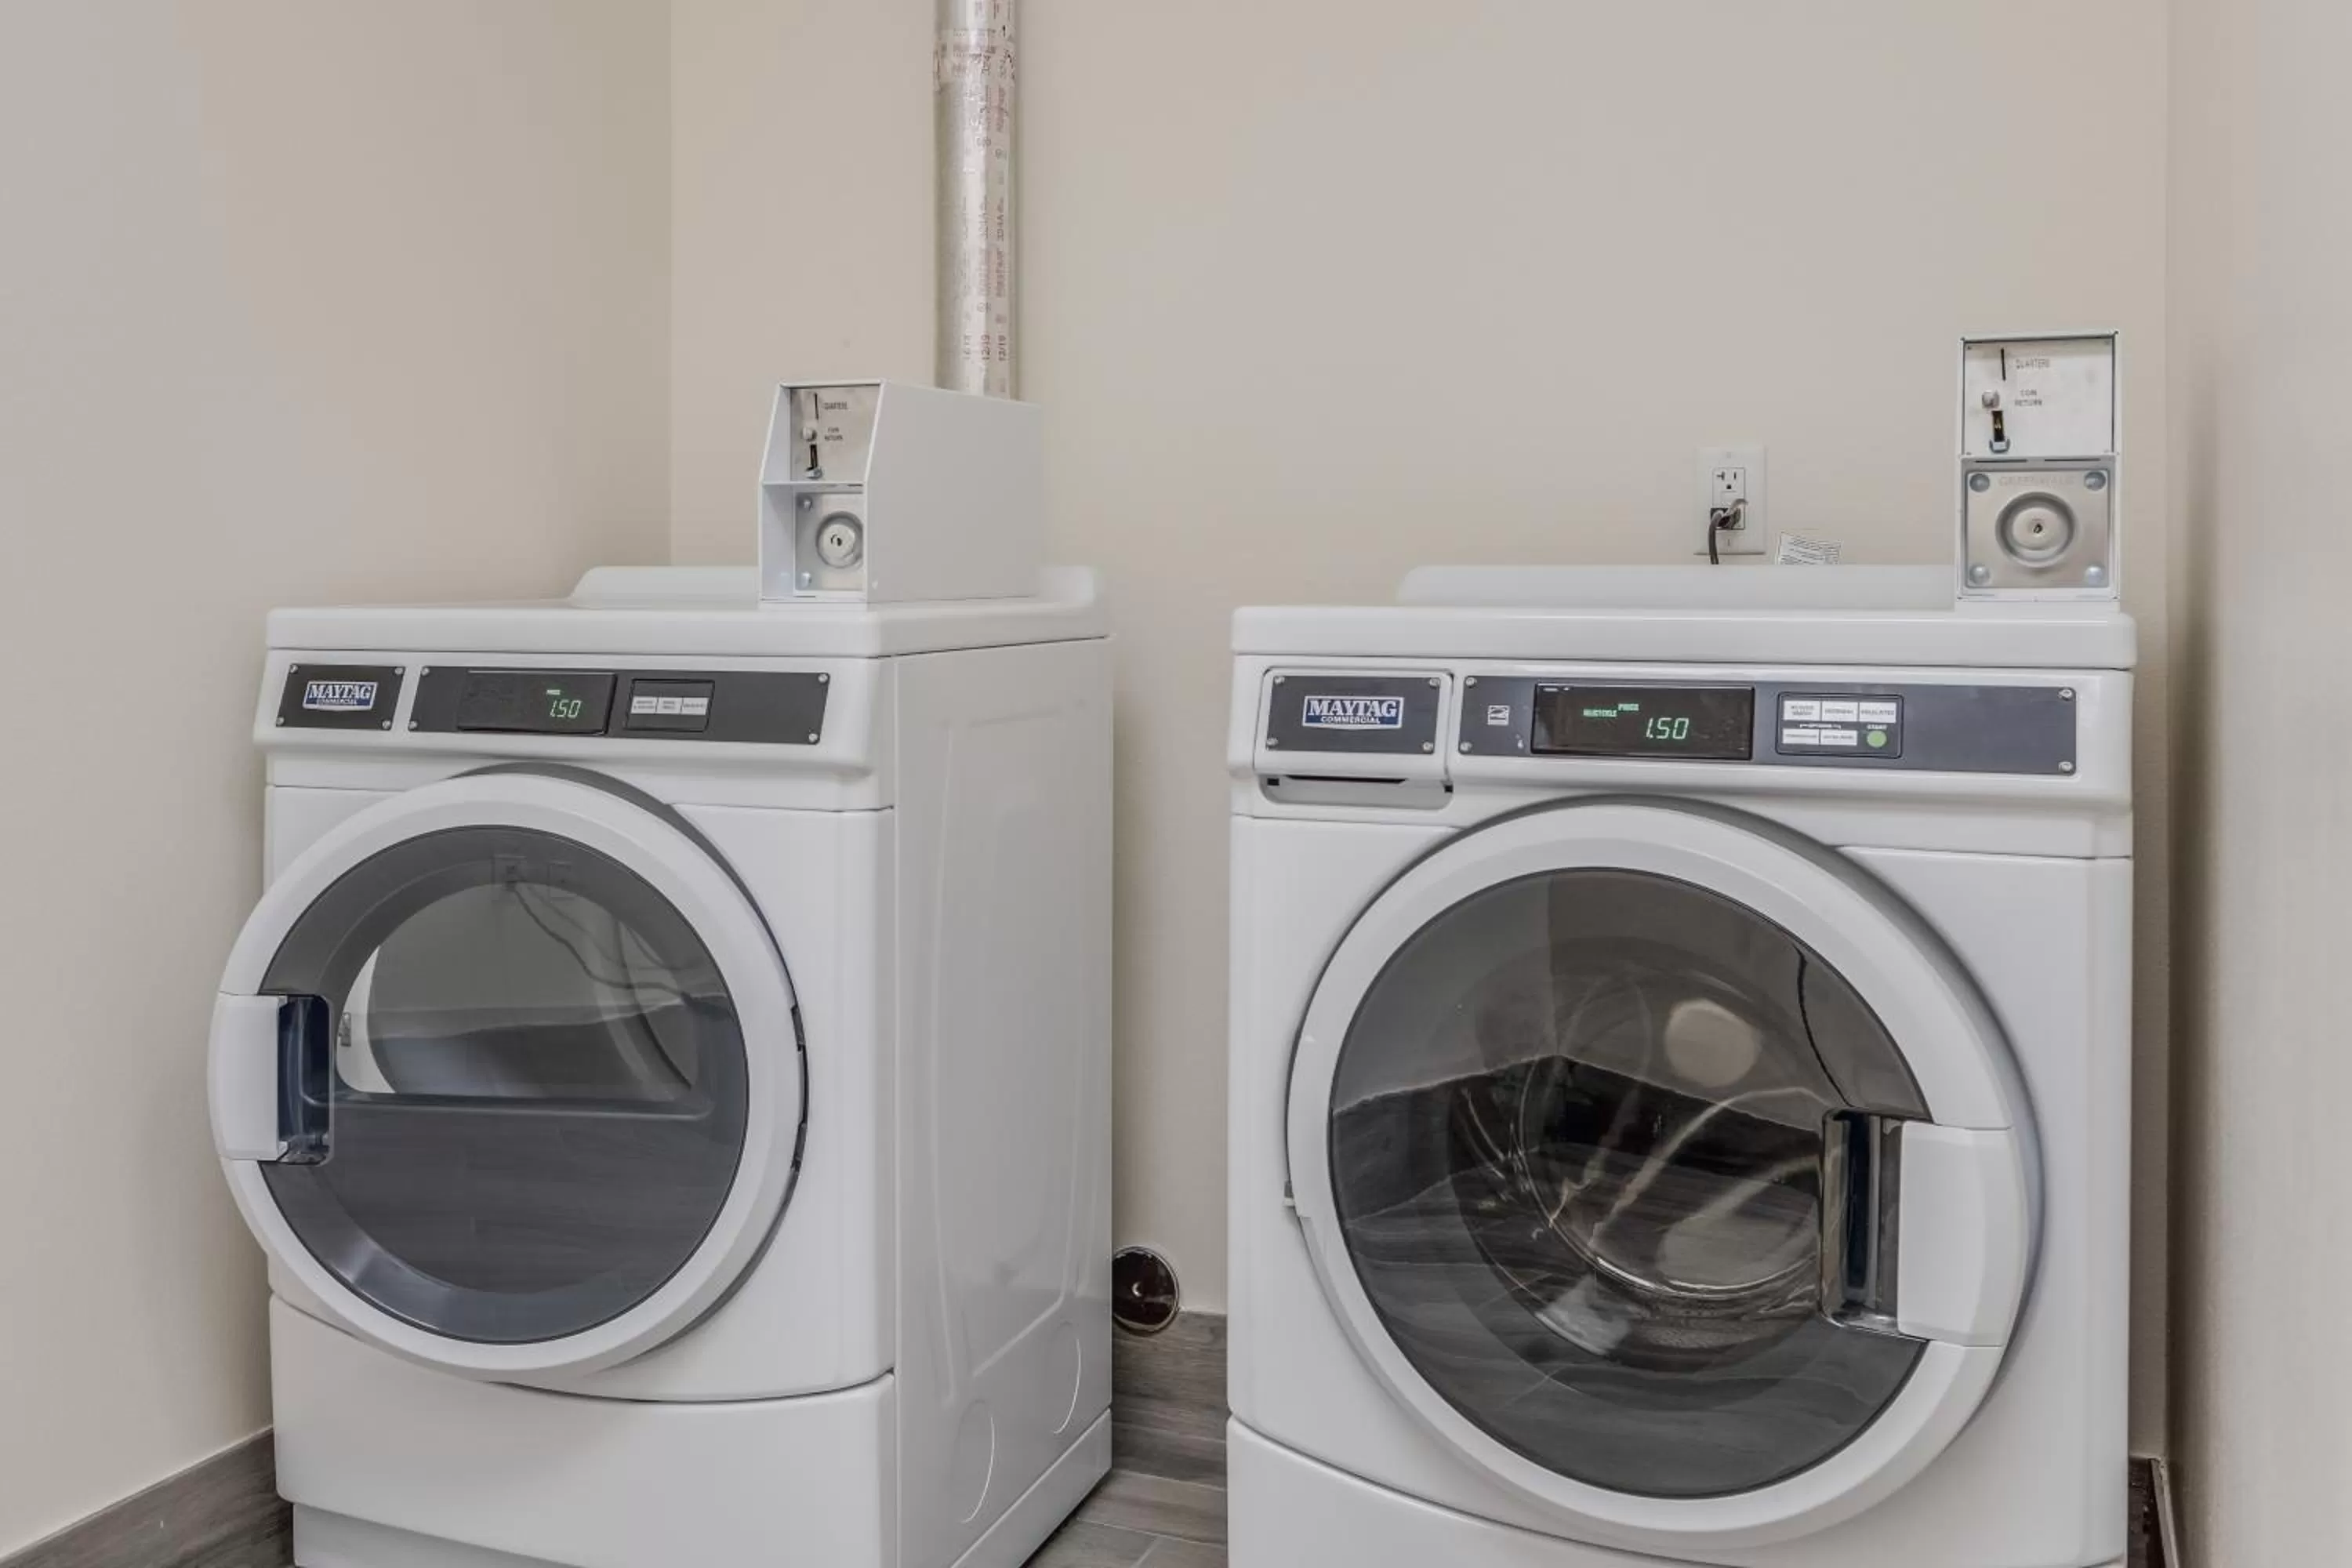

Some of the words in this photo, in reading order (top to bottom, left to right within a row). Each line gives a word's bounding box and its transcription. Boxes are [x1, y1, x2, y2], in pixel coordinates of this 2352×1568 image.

[308, 684, 372, 699] MAYTAG
[1308, 700, 1397, 717] MAYTAG
[1320, 715, 1381, 724] COMMERCIAL
